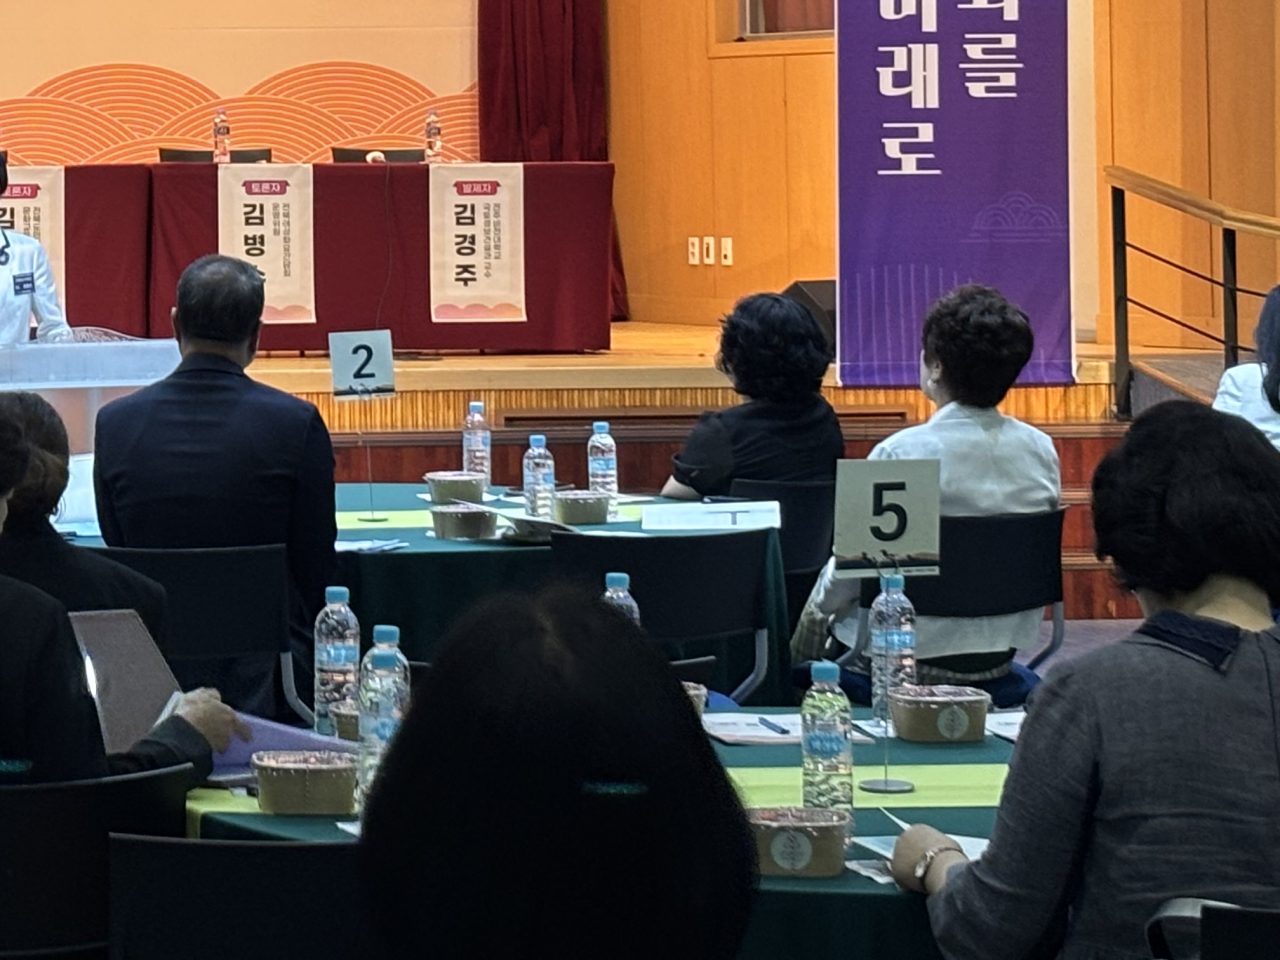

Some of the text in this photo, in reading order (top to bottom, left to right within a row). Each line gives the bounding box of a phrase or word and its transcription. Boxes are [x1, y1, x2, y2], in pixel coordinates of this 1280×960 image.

[251, 182, 281, 193] 토론자
[463, 183, 492, 194] 발제자
[454, 203, 477, 287] 김경주
[351, 343, 376, 379] 2
[869, 481, 907, 542] 5
